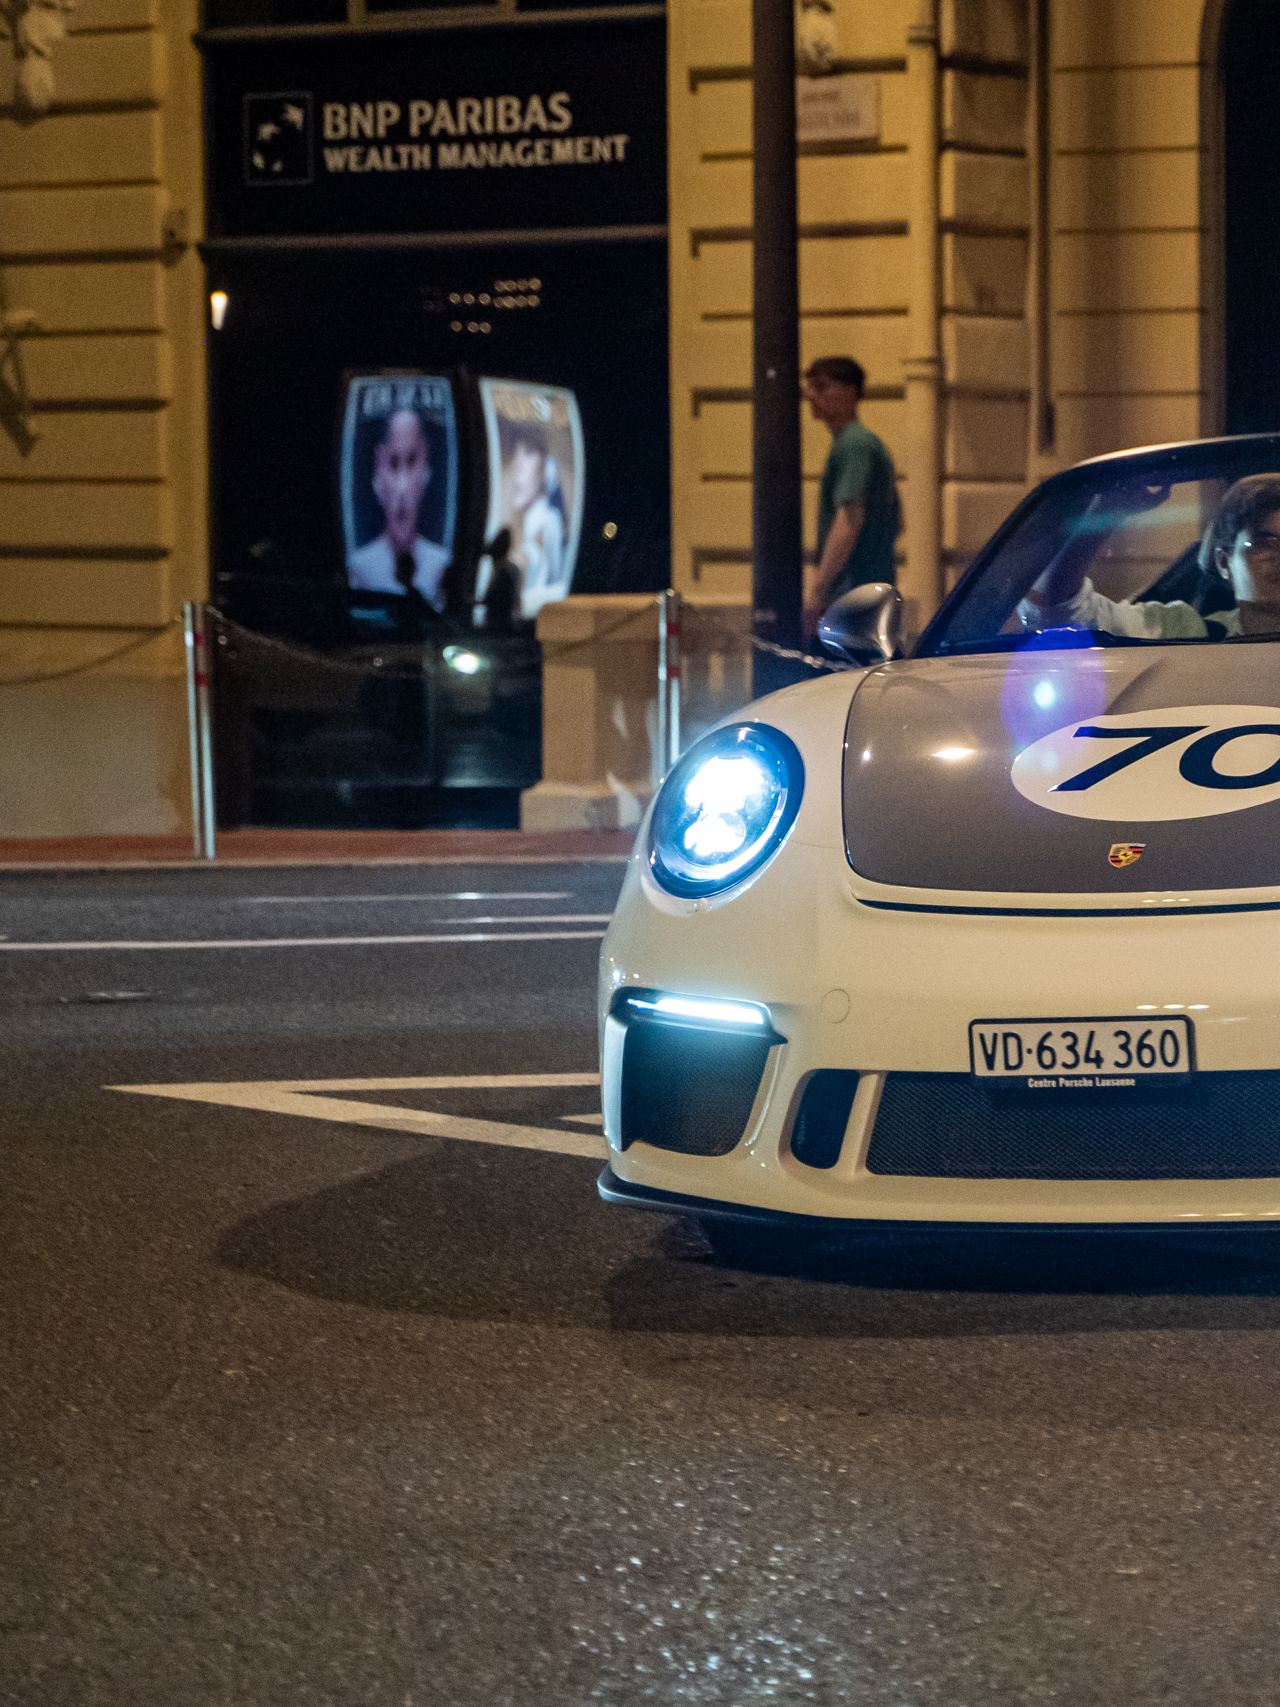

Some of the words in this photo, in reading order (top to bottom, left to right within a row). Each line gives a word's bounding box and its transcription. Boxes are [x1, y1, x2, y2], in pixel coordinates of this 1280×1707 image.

[323, 101, 401, 140] BNP
[408, 91, 573, 138] PARIBAS
[322, 144, 432, 173] WEALTH
[436, 133, 630, 170] MANAGEMENT
[1028, 1078, 1057, 1088] Centre
[1059, 1077, 1094, 1087] Porsche
[1096, 1077, 1136, 1087] Lausanne
